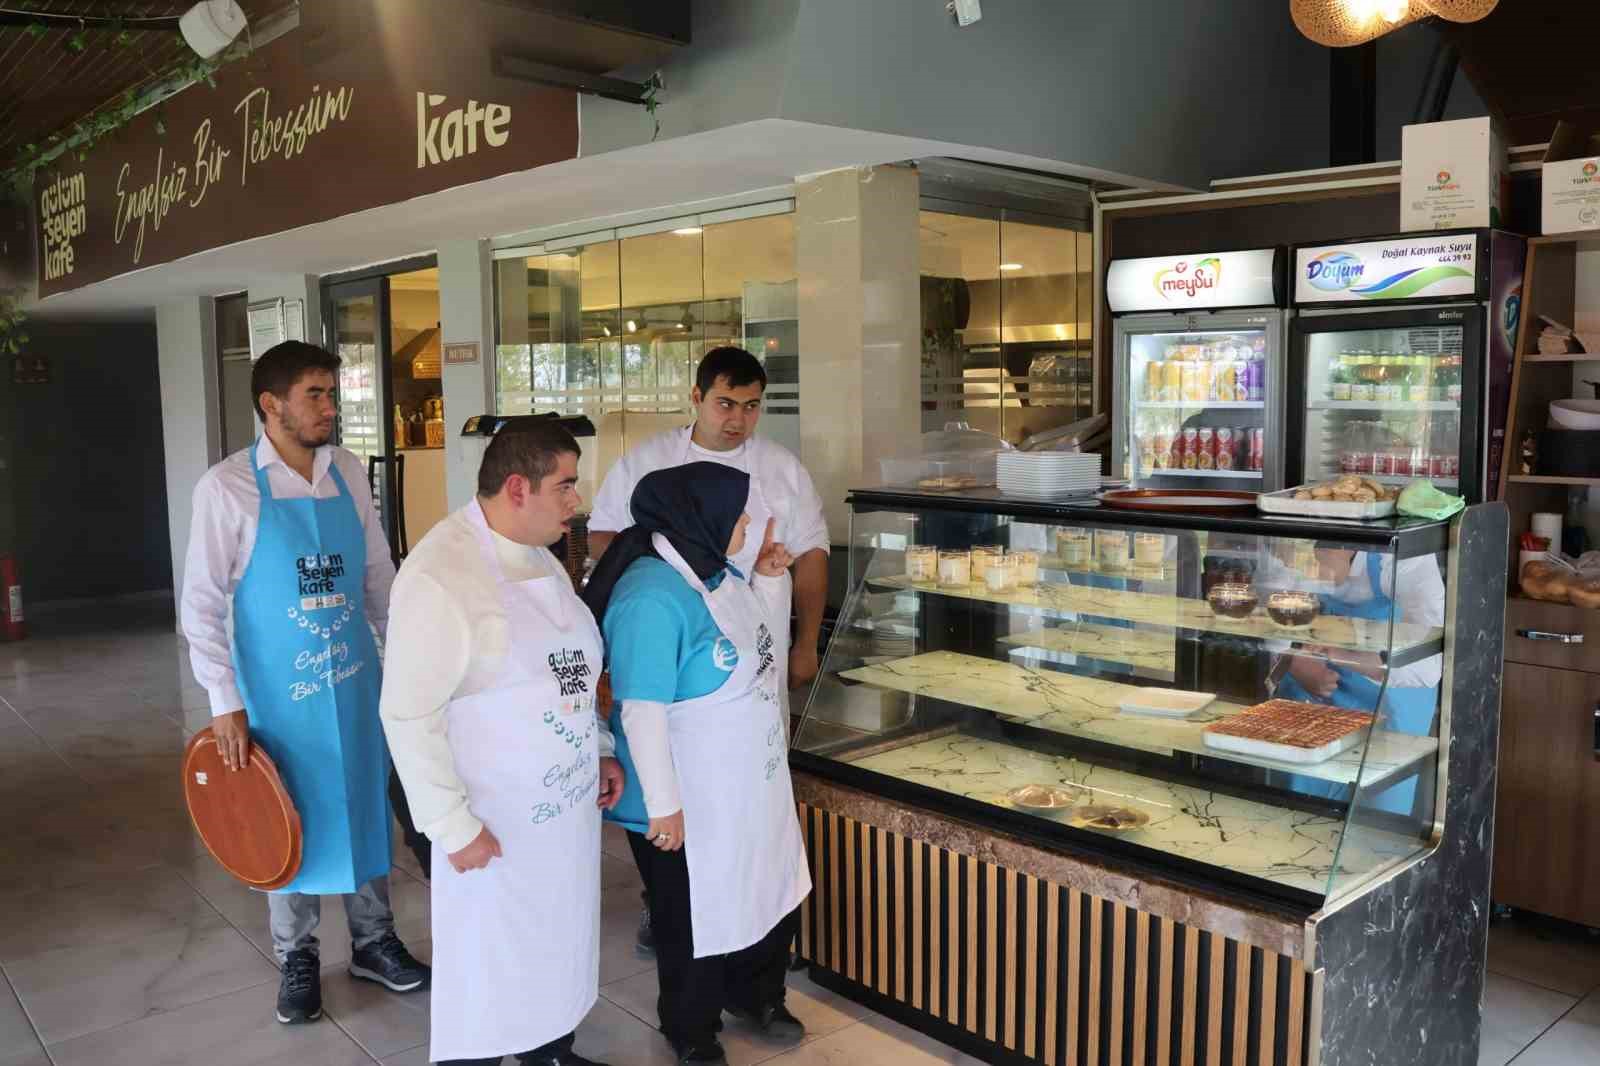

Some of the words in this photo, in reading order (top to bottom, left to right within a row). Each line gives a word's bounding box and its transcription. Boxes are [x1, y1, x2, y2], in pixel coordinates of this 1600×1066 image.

[115, 149, 187, 264] Engelsiz
[190, 118, 231, 208] Bir
[233, 84, 354, 187] Tebessüm
[41, 171, 86, 219] gülüm
[44, 234, 74, 280] kafe
[1410, 245, 1446, 257] Kaynak
[1307, 260, 1364, 283] Doyum
[298, 576, 335, 595] kafe
[554, 674, 588, 697] kafe
